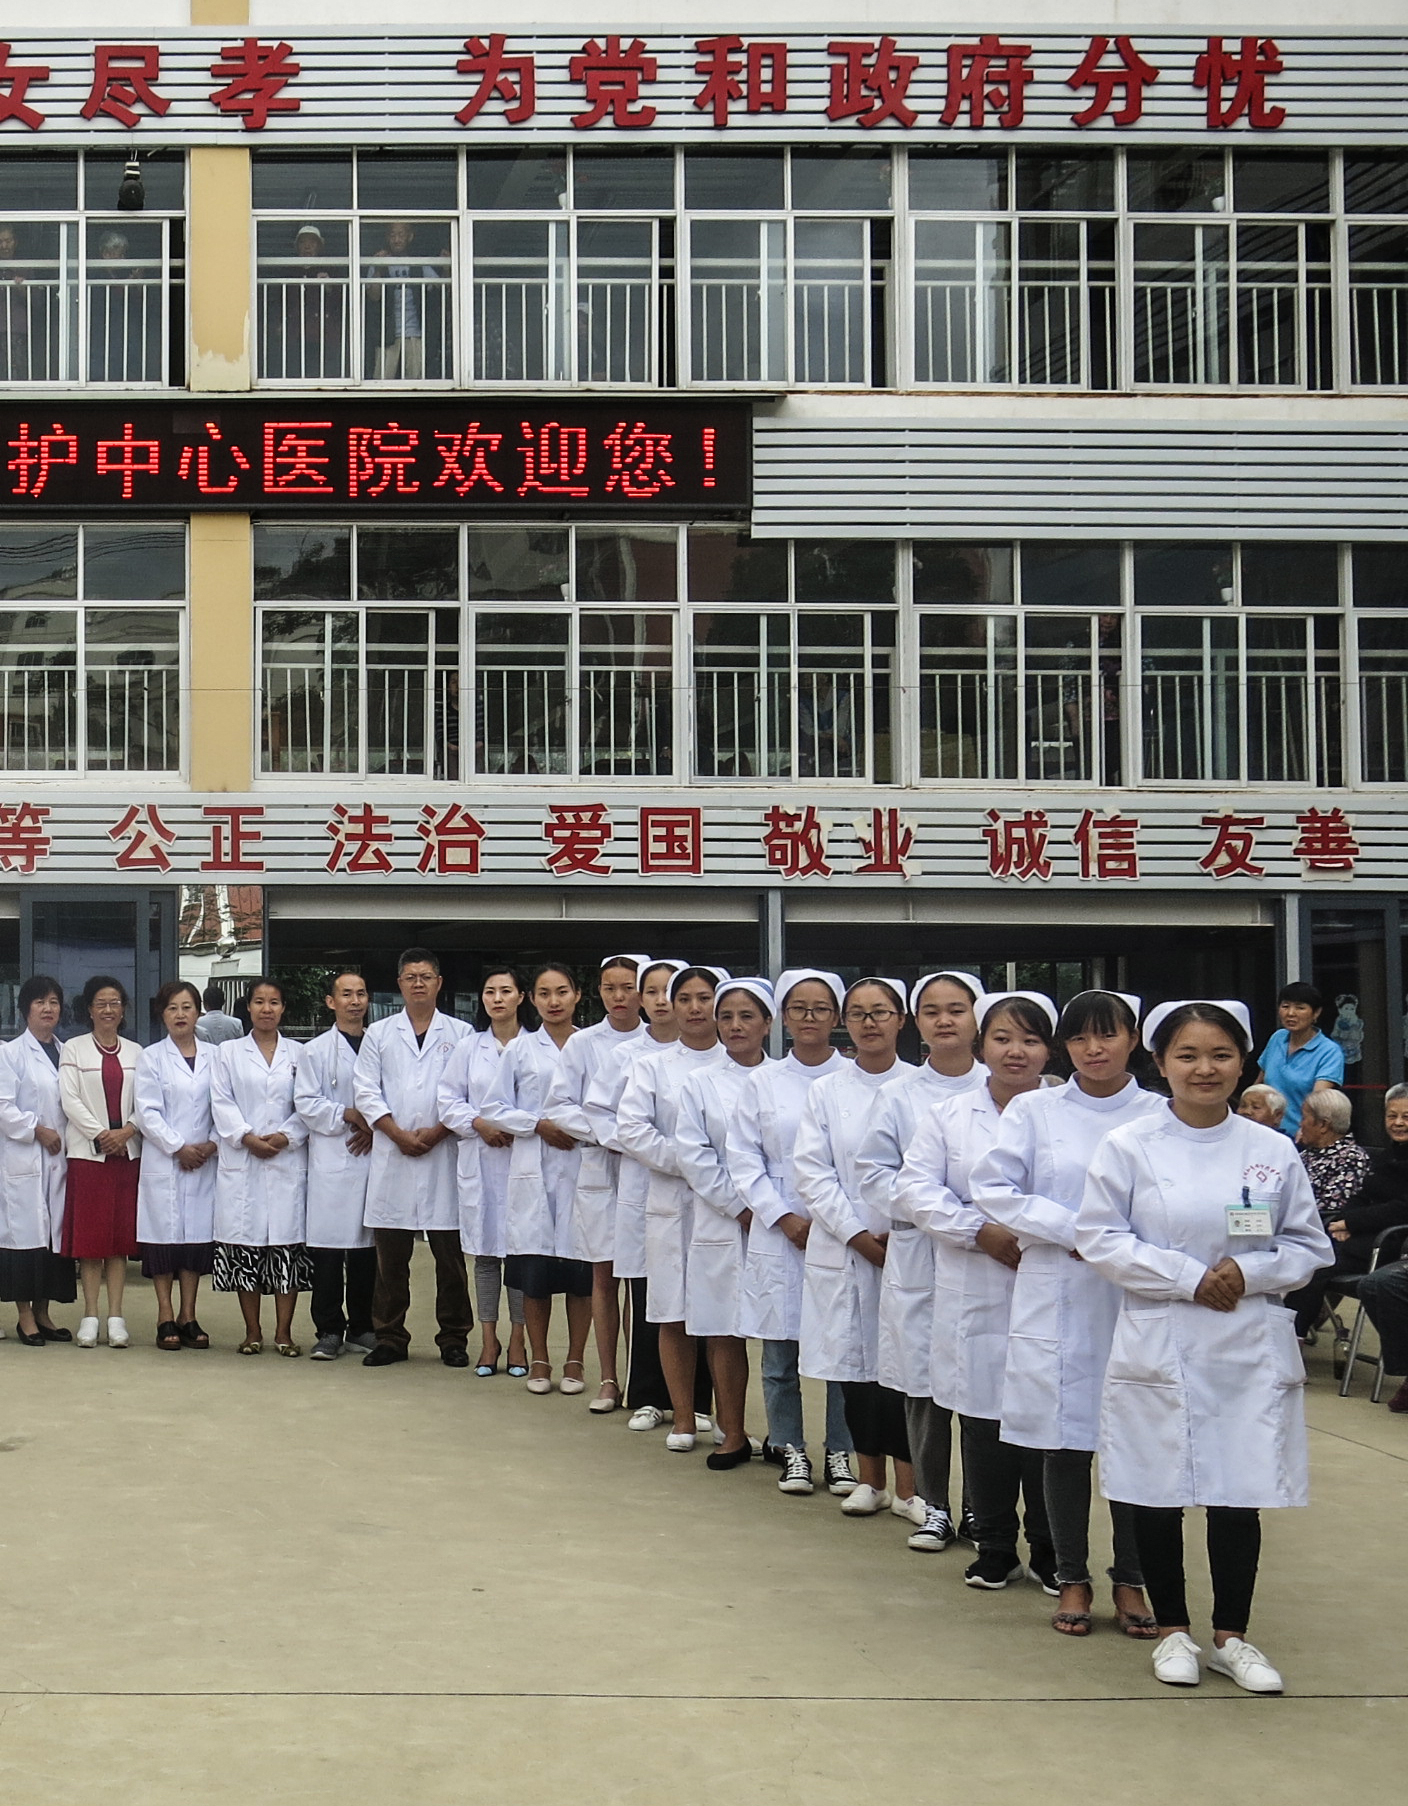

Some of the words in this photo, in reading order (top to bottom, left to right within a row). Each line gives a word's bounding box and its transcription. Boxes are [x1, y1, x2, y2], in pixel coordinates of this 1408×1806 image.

[455, 33, 1288, 129] 为党和政府分忧
[110, 804, 266, 872] 公正
[326, 803, 486, 874] 法治
[545, 804, 703, 875] 爱国
[763, 805, 913, 878] 敬业
[983, 808, 1139, 878] 诚信
[1200, 807, 1360, 877] 友善
